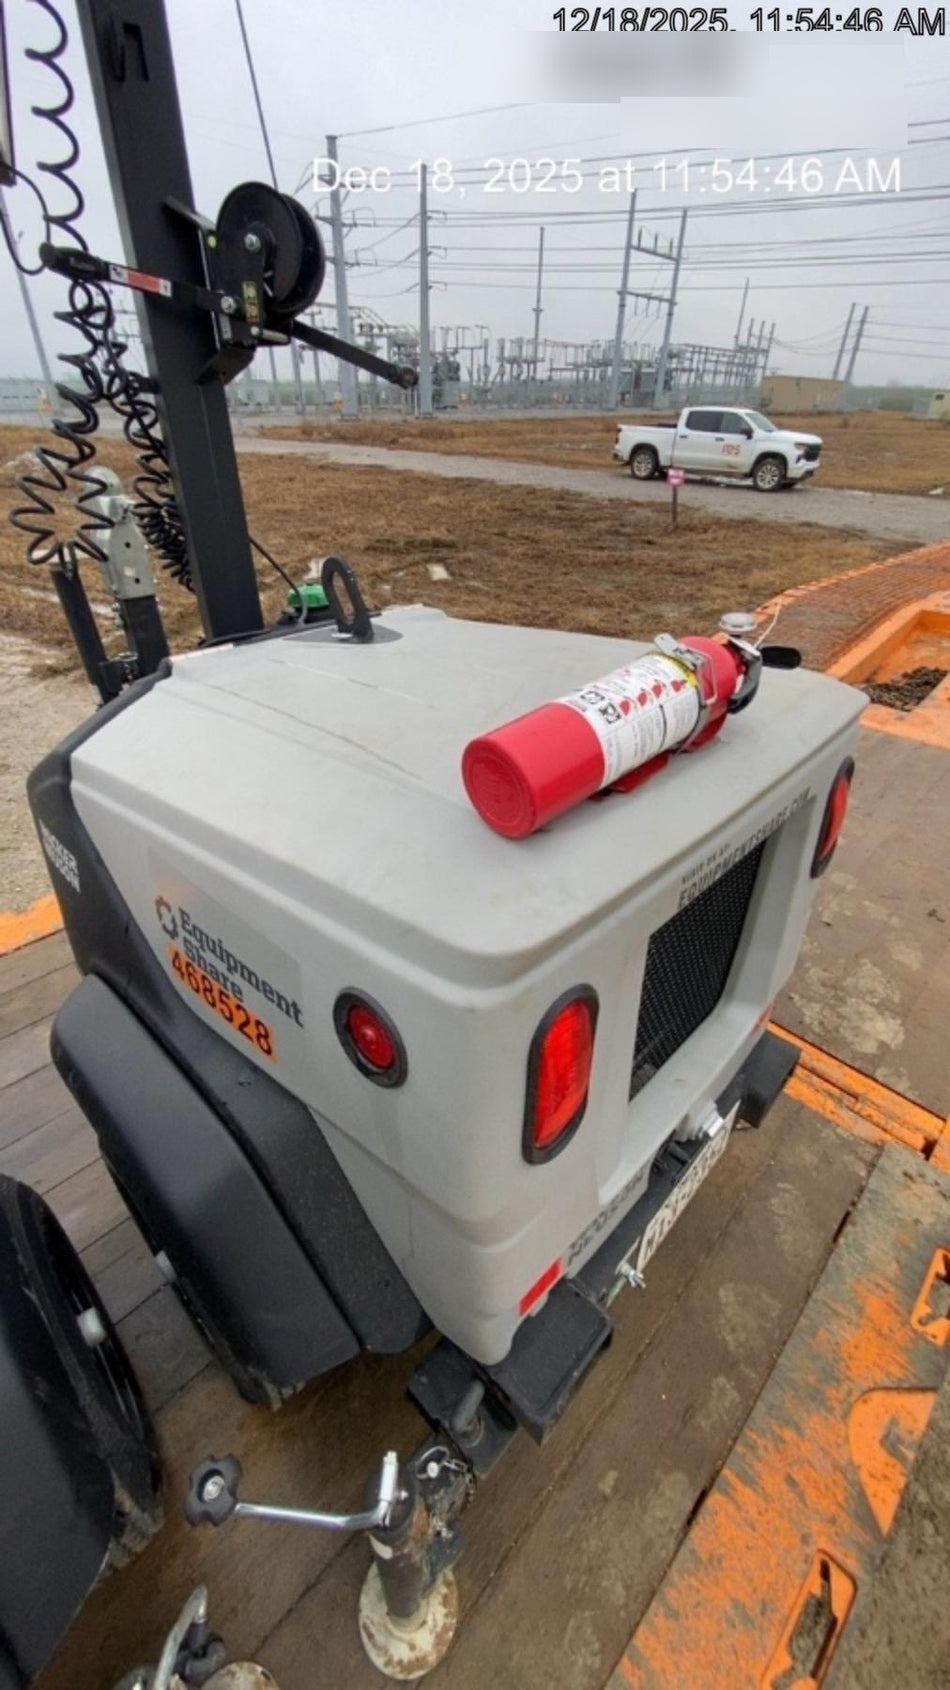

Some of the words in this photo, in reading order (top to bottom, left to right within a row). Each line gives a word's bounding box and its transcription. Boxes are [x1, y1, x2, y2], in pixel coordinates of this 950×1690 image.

[172, 950, 273, 1056] 468528
[178, 906, 304, 1029] Equipment
[182, 936, 244, 1003] Share
